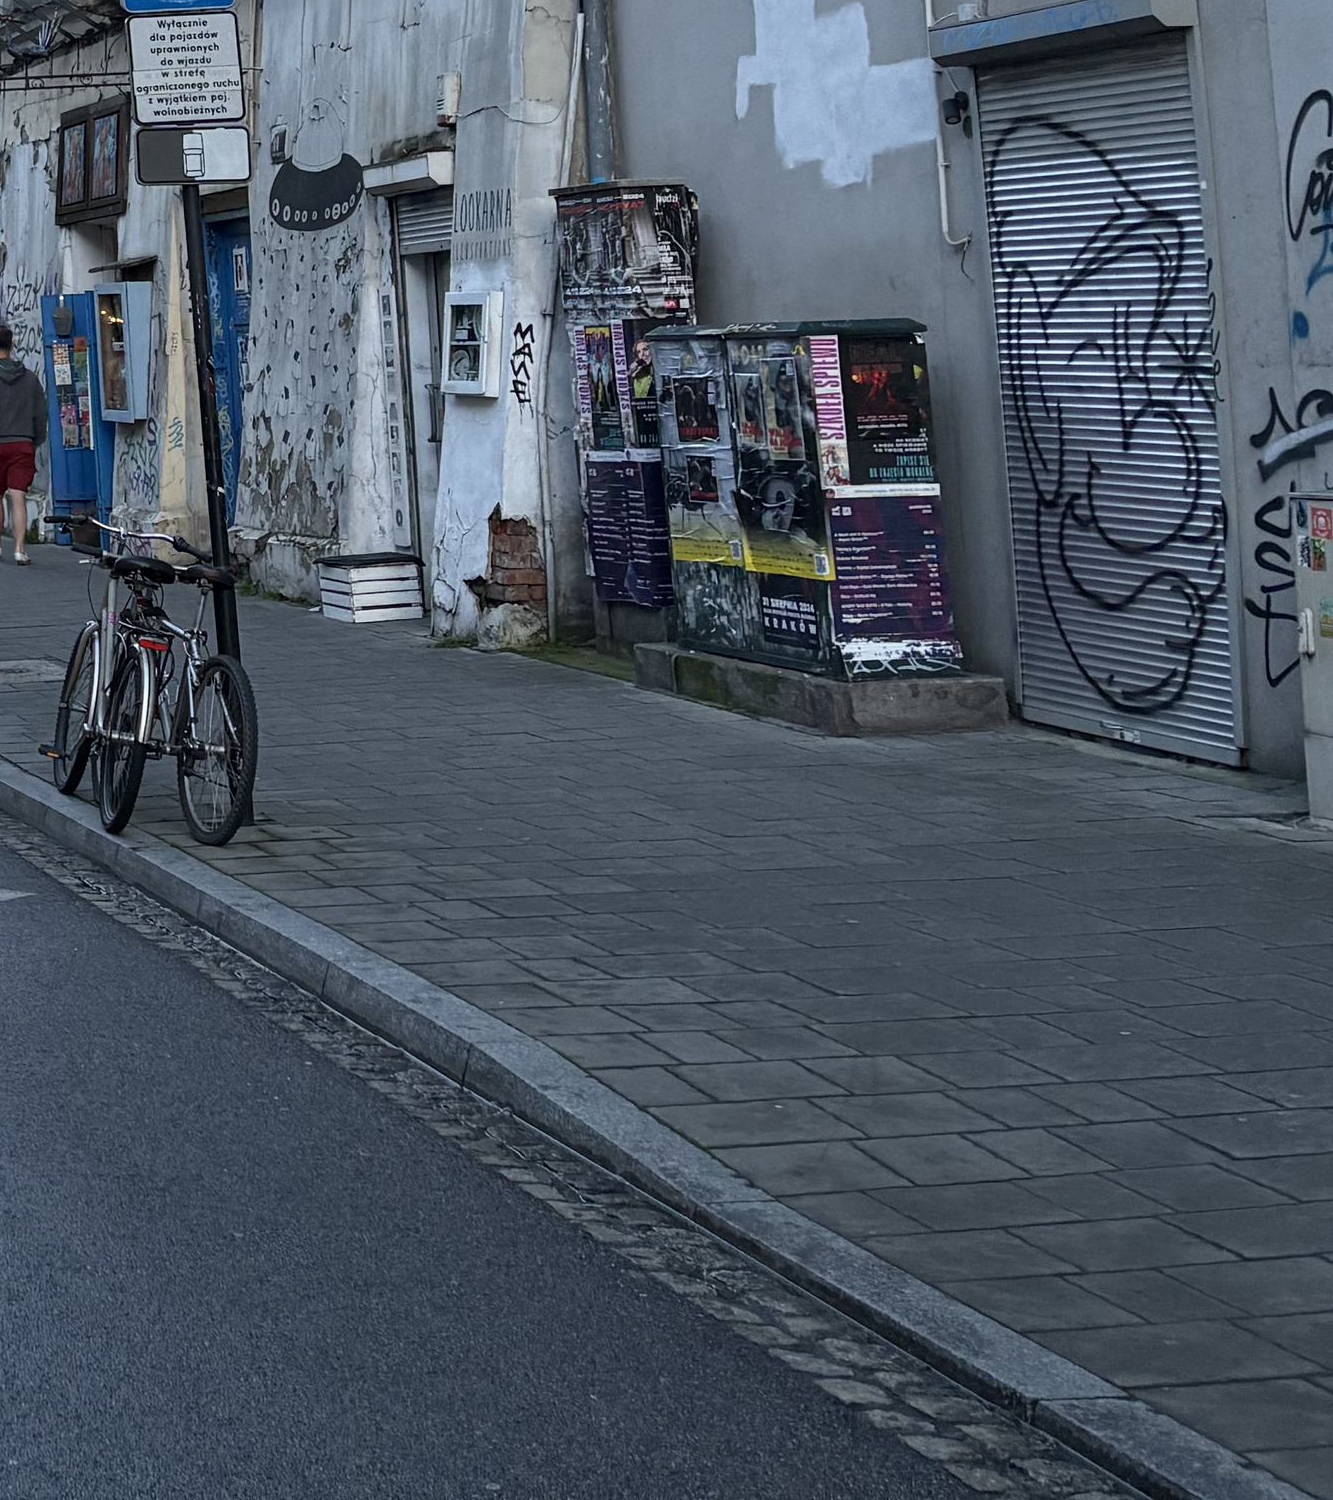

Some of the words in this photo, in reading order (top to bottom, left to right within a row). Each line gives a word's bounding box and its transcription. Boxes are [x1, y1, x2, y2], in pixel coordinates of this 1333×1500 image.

[157, 18, 208, 31] Wyłącznie
[149, 33, 166, 42] dla
[170, 30, 219, 43] pojazdów
[150, 42, 220, 56] uprawnionych
[160, 57, 173, 67] do
[177, 55, 212, 67] wjazdu
[161, 70, 170, 78] w
[174, 68, 206, 79] strefę
[136, 81, 210, 95] ograniczonego
[213, 78, 240, 88] ruchu
[156, 94, 207, 106] wyjątkiem
[211, 91, 231, 103] poj.
[153, 104, 228, 117] wolnobieżnych
[809, 338, 840, 388] ŚPIEWU
[815, 392, 845, 440] SZKOŁA
[764, 616, 817, 635] KRAKÓW
